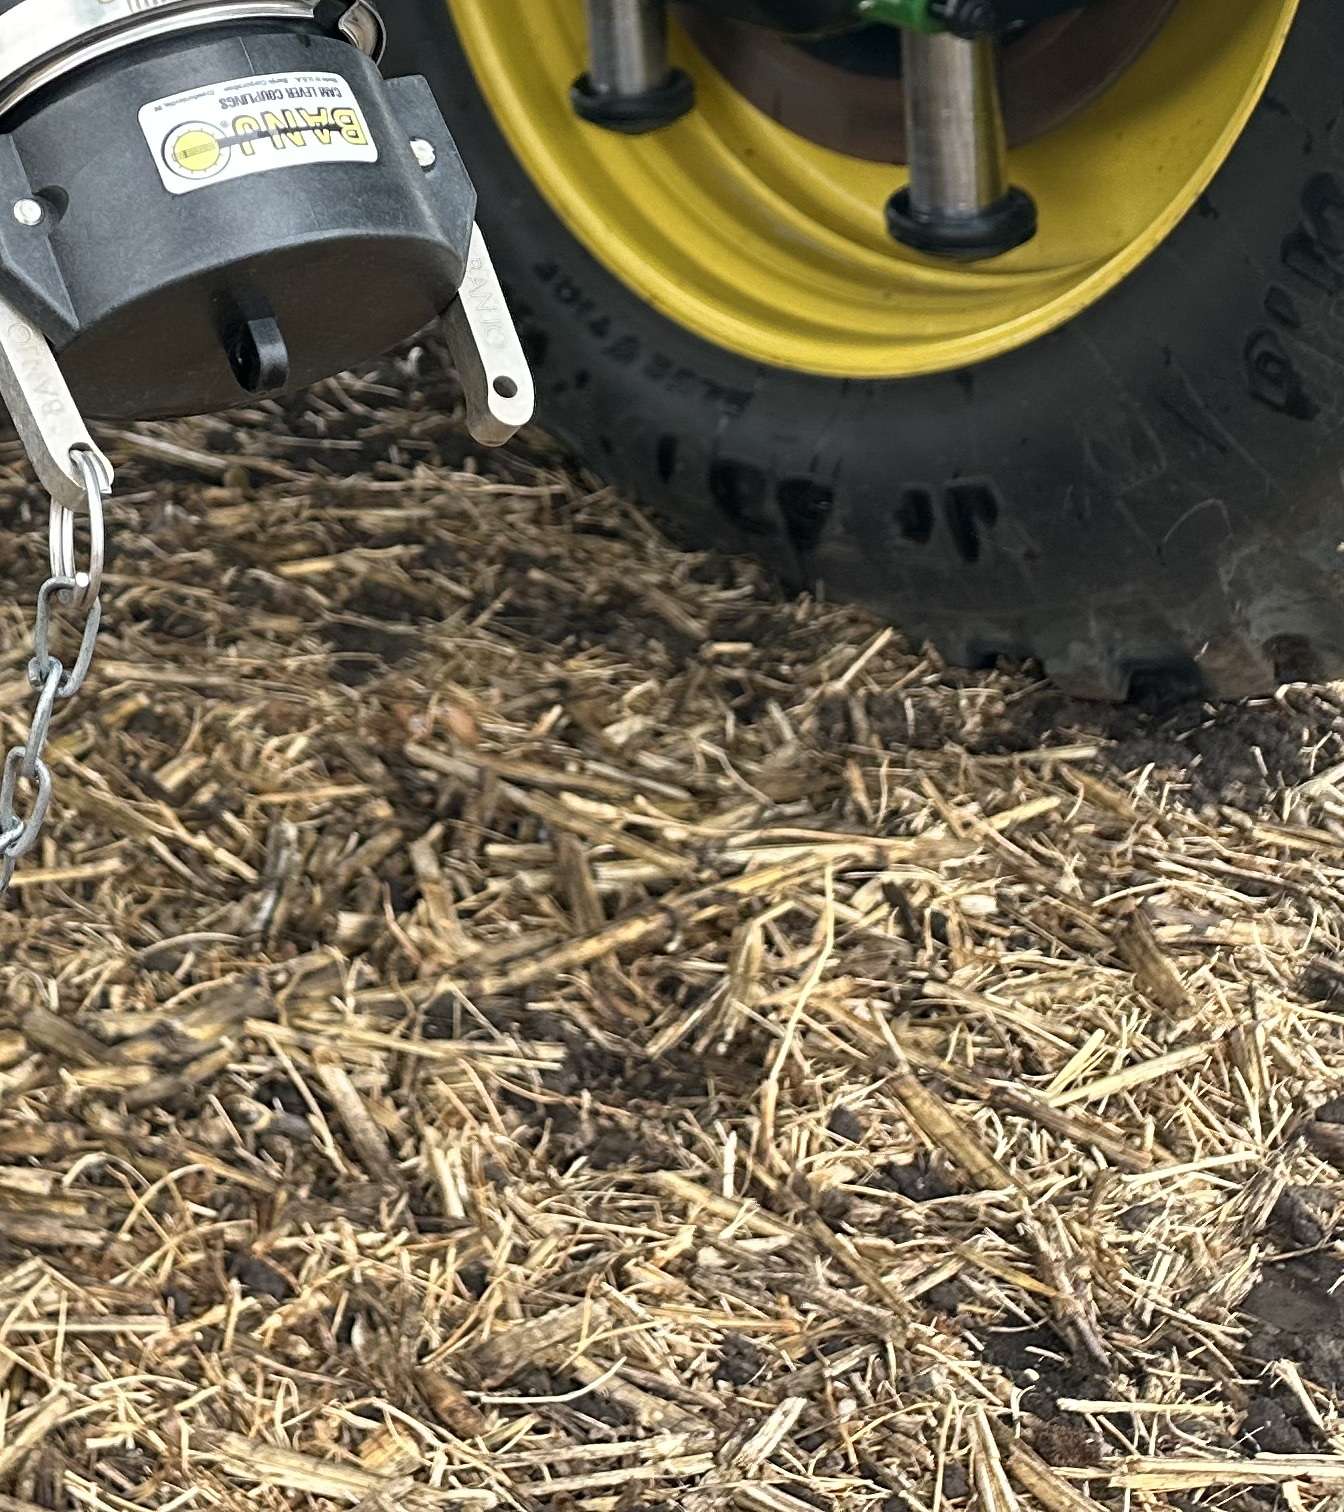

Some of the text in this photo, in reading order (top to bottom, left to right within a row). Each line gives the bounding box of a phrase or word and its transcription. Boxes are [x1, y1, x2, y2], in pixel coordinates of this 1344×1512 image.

[218, 86, 342, 110] CAM LEVER COUPLINGS
[161, 106, 368, 180] BANJO
